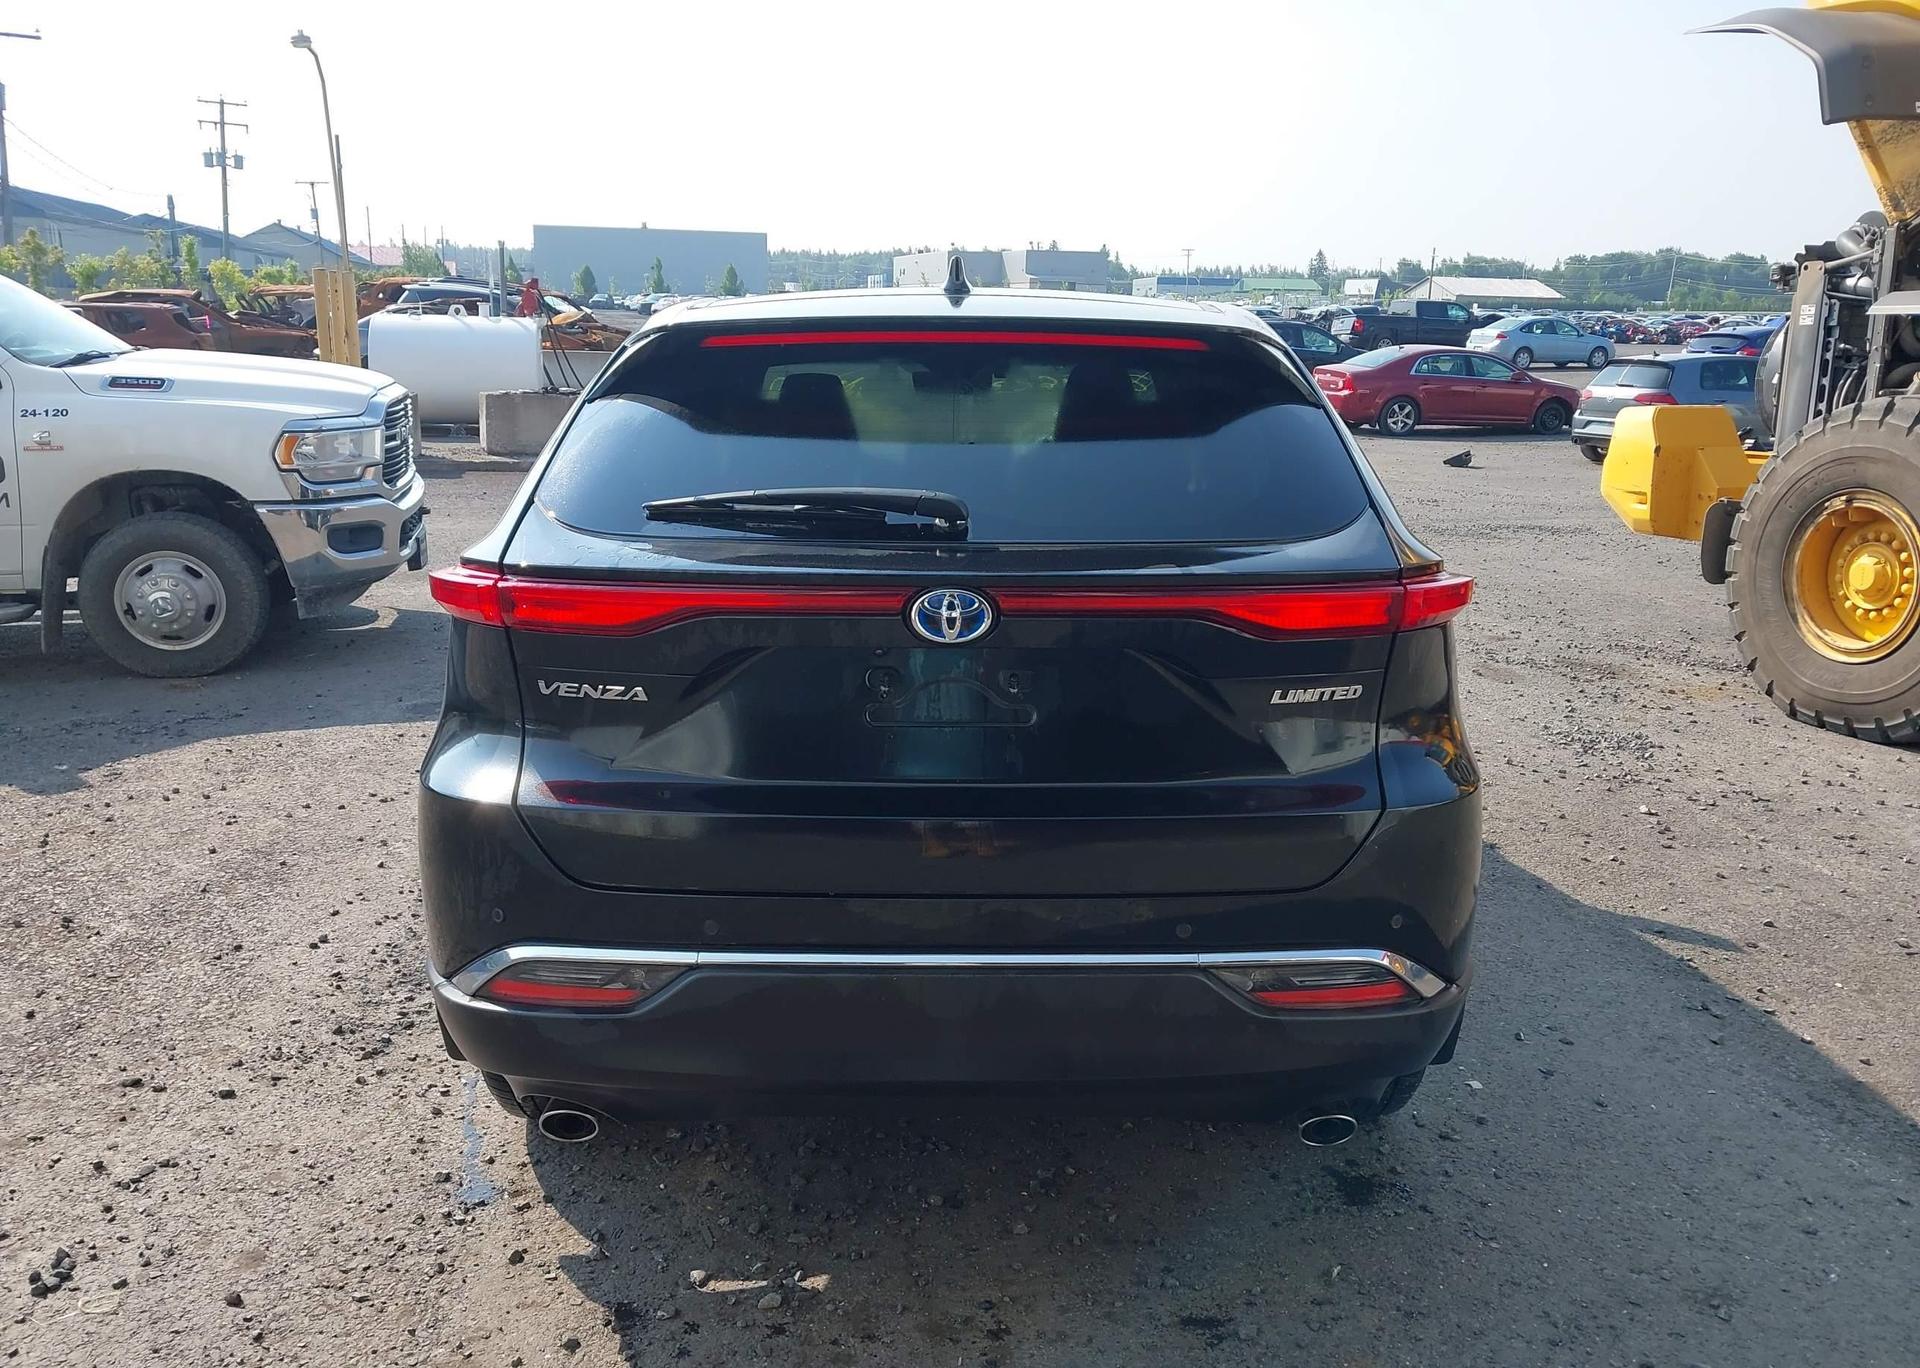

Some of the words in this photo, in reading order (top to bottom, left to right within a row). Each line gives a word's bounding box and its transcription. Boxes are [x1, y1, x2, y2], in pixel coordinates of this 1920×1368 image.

[114, 378, 162, 386] 3500
[20, 408, 69, 418] 24-120
[538, 680, 648, 702] VENZA
[1270, 684, 1363, 705] LIMITED
